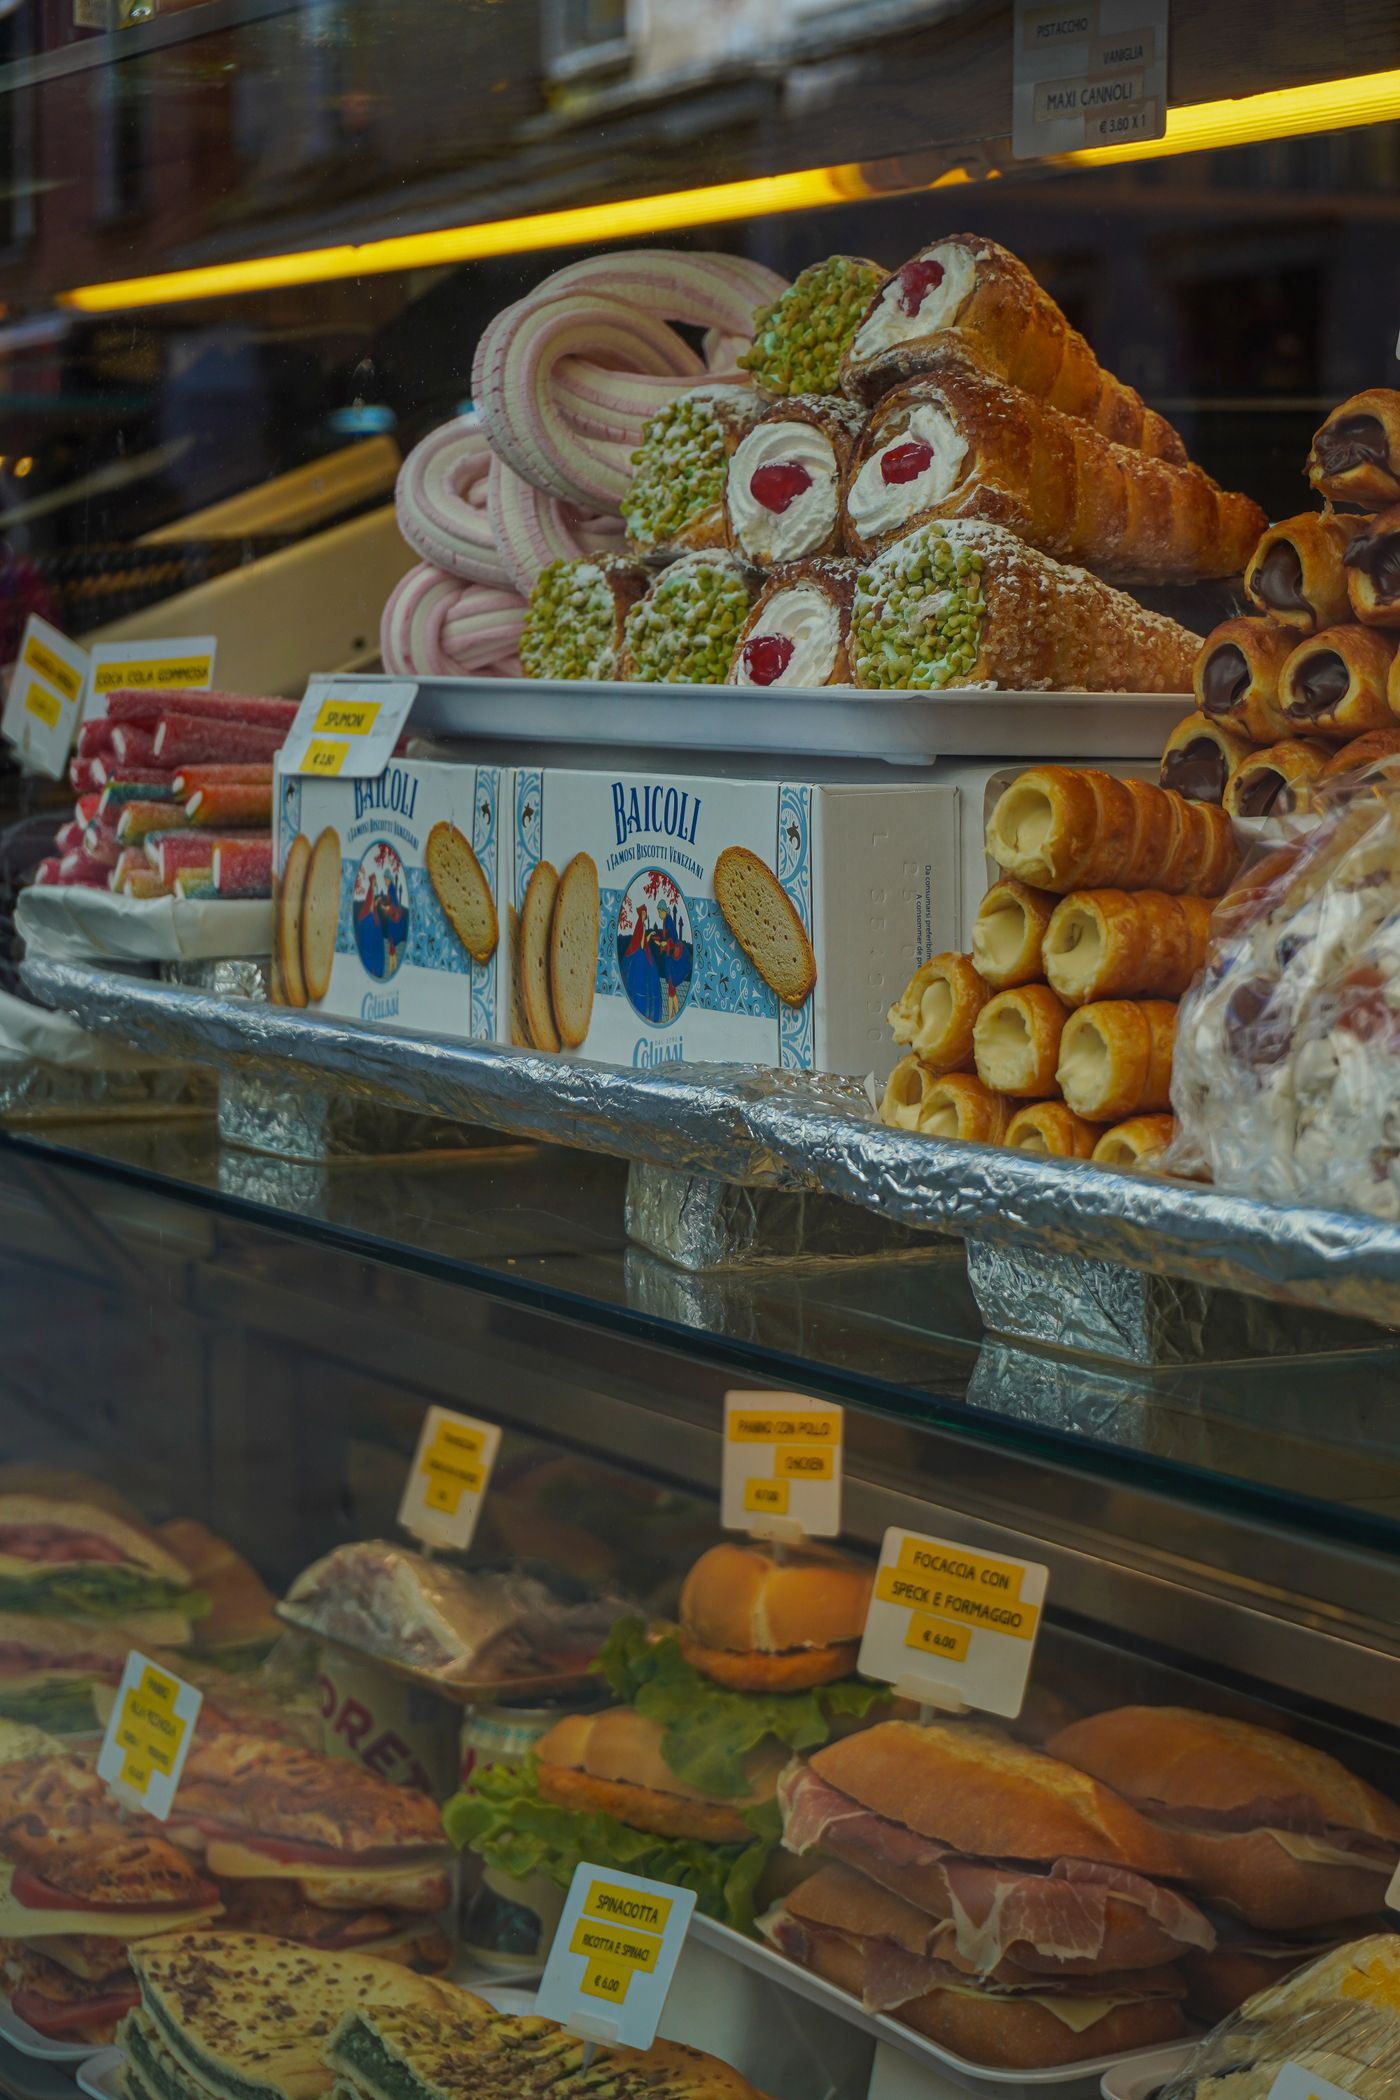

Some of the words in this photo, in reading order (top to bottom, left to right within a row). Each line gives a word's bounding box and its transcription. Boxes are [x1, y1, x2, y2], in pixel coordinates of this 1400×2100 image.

[1037, 18, 1088, 38] PISTACCHIO
[1103, 45, 1144, 64] VANIGLIA
[1046, 91, 1076, 111] MAXI
[1080, 82, 1132, 105] CANNOLI
[1099, 120, 1107, 134] €
[1109, 117, 1129, 132] 3.80
[1132, 116, 1138, 128] X
[611, 782, 702, 846] BAICOLI
[610, 847, 636, 870] FAMOSI
[636, 843, 668, 861] BISCOTTI
[669, 845, 704, 880] VENEZIANI
[917, 946, 923, 956] de
[798, 1421, 831, 1436] POLLO
[913, 1551, 976, 1580] FOCACCIA
[979, 1569, 1011, 1590] CON
[891, 1581, 929, 1604] SPECK
[932, 1592, 942, 1606] E
[943, 1594, 1023, 1628] FORMAGGIO
[922, 1630, 931, 1642] €
[933, 1634, 956, 1650] 6.00
[595, 1894, 659, 1925] SPINACIOTTA
[581, 1933, 614, 1952] RICOTTA
[614, 1942, 622, 1955] E
[622, 1943, 650, 1962] SPINACI
[594, 1975, 601, 1987] €
[602, 1976, 620, 1992] 6.00
